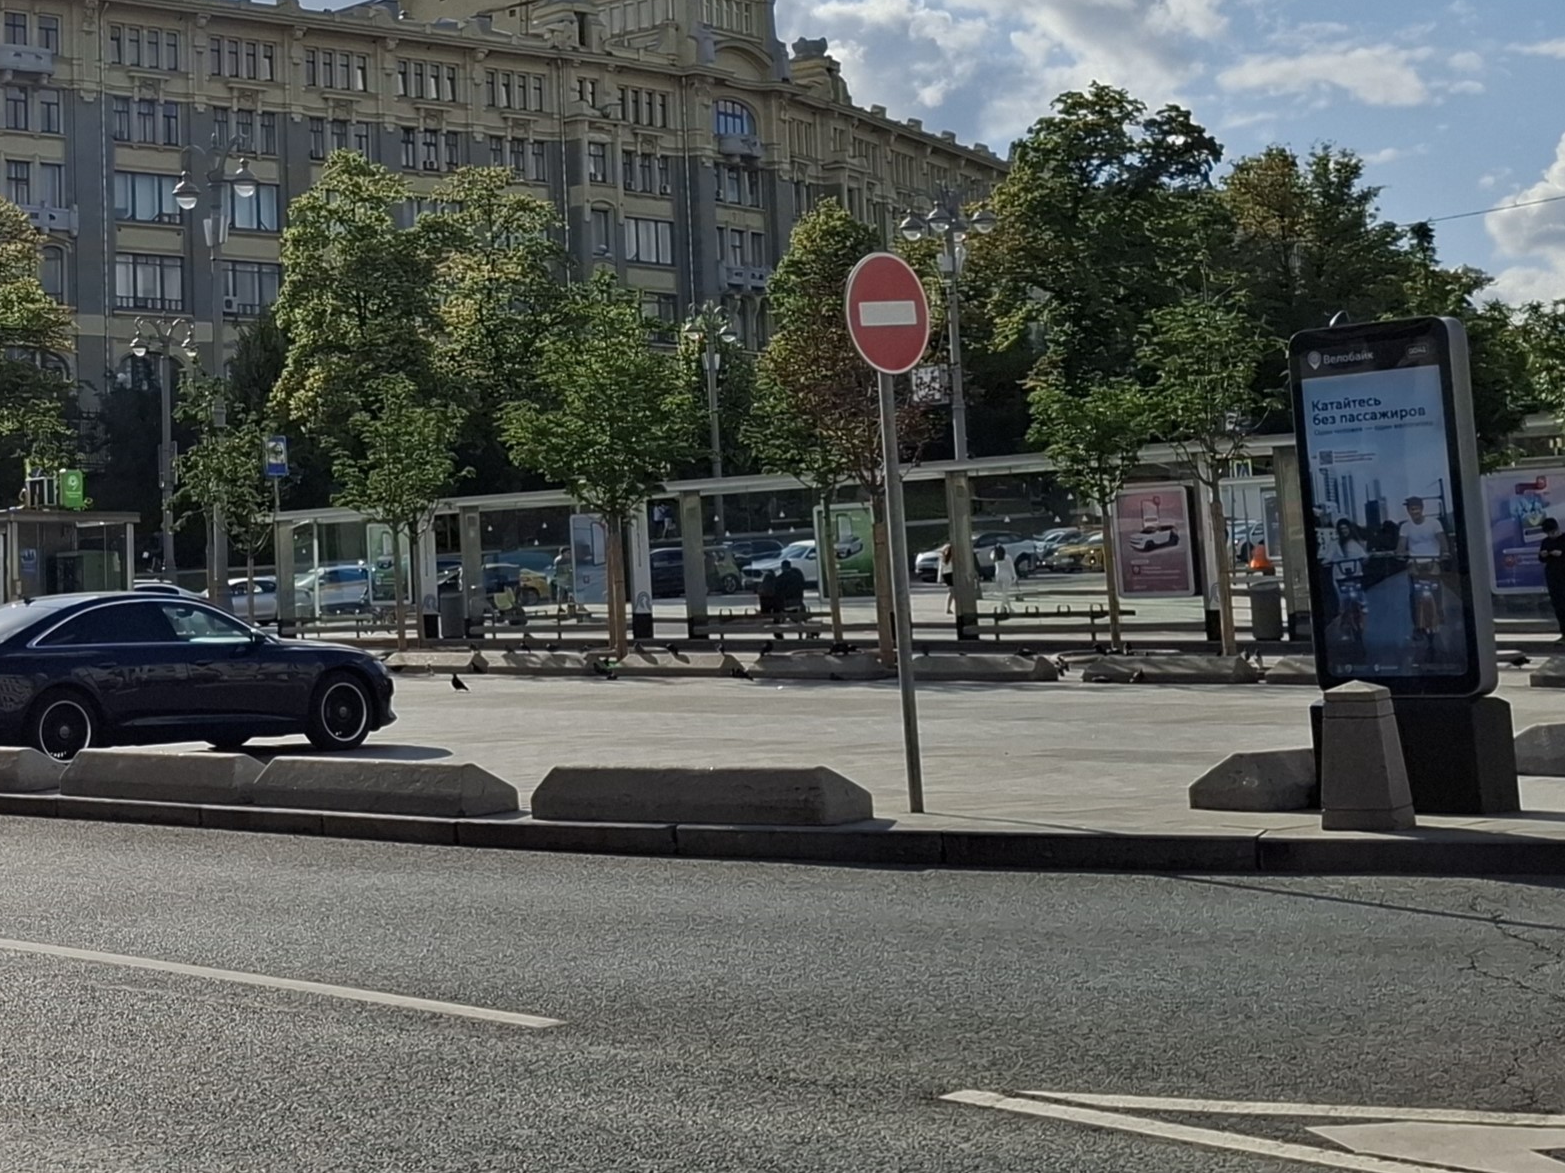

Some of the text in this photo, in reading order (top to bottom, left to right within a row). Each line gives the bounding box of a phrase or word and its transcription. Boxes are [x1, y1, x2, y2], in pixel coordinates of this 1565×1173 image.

[1323, 351, 1374, 364] Велобайк
[1312, 397, 1382, 413] Катайтесь
[1312, 407, 1426, 426] без пассажиров
